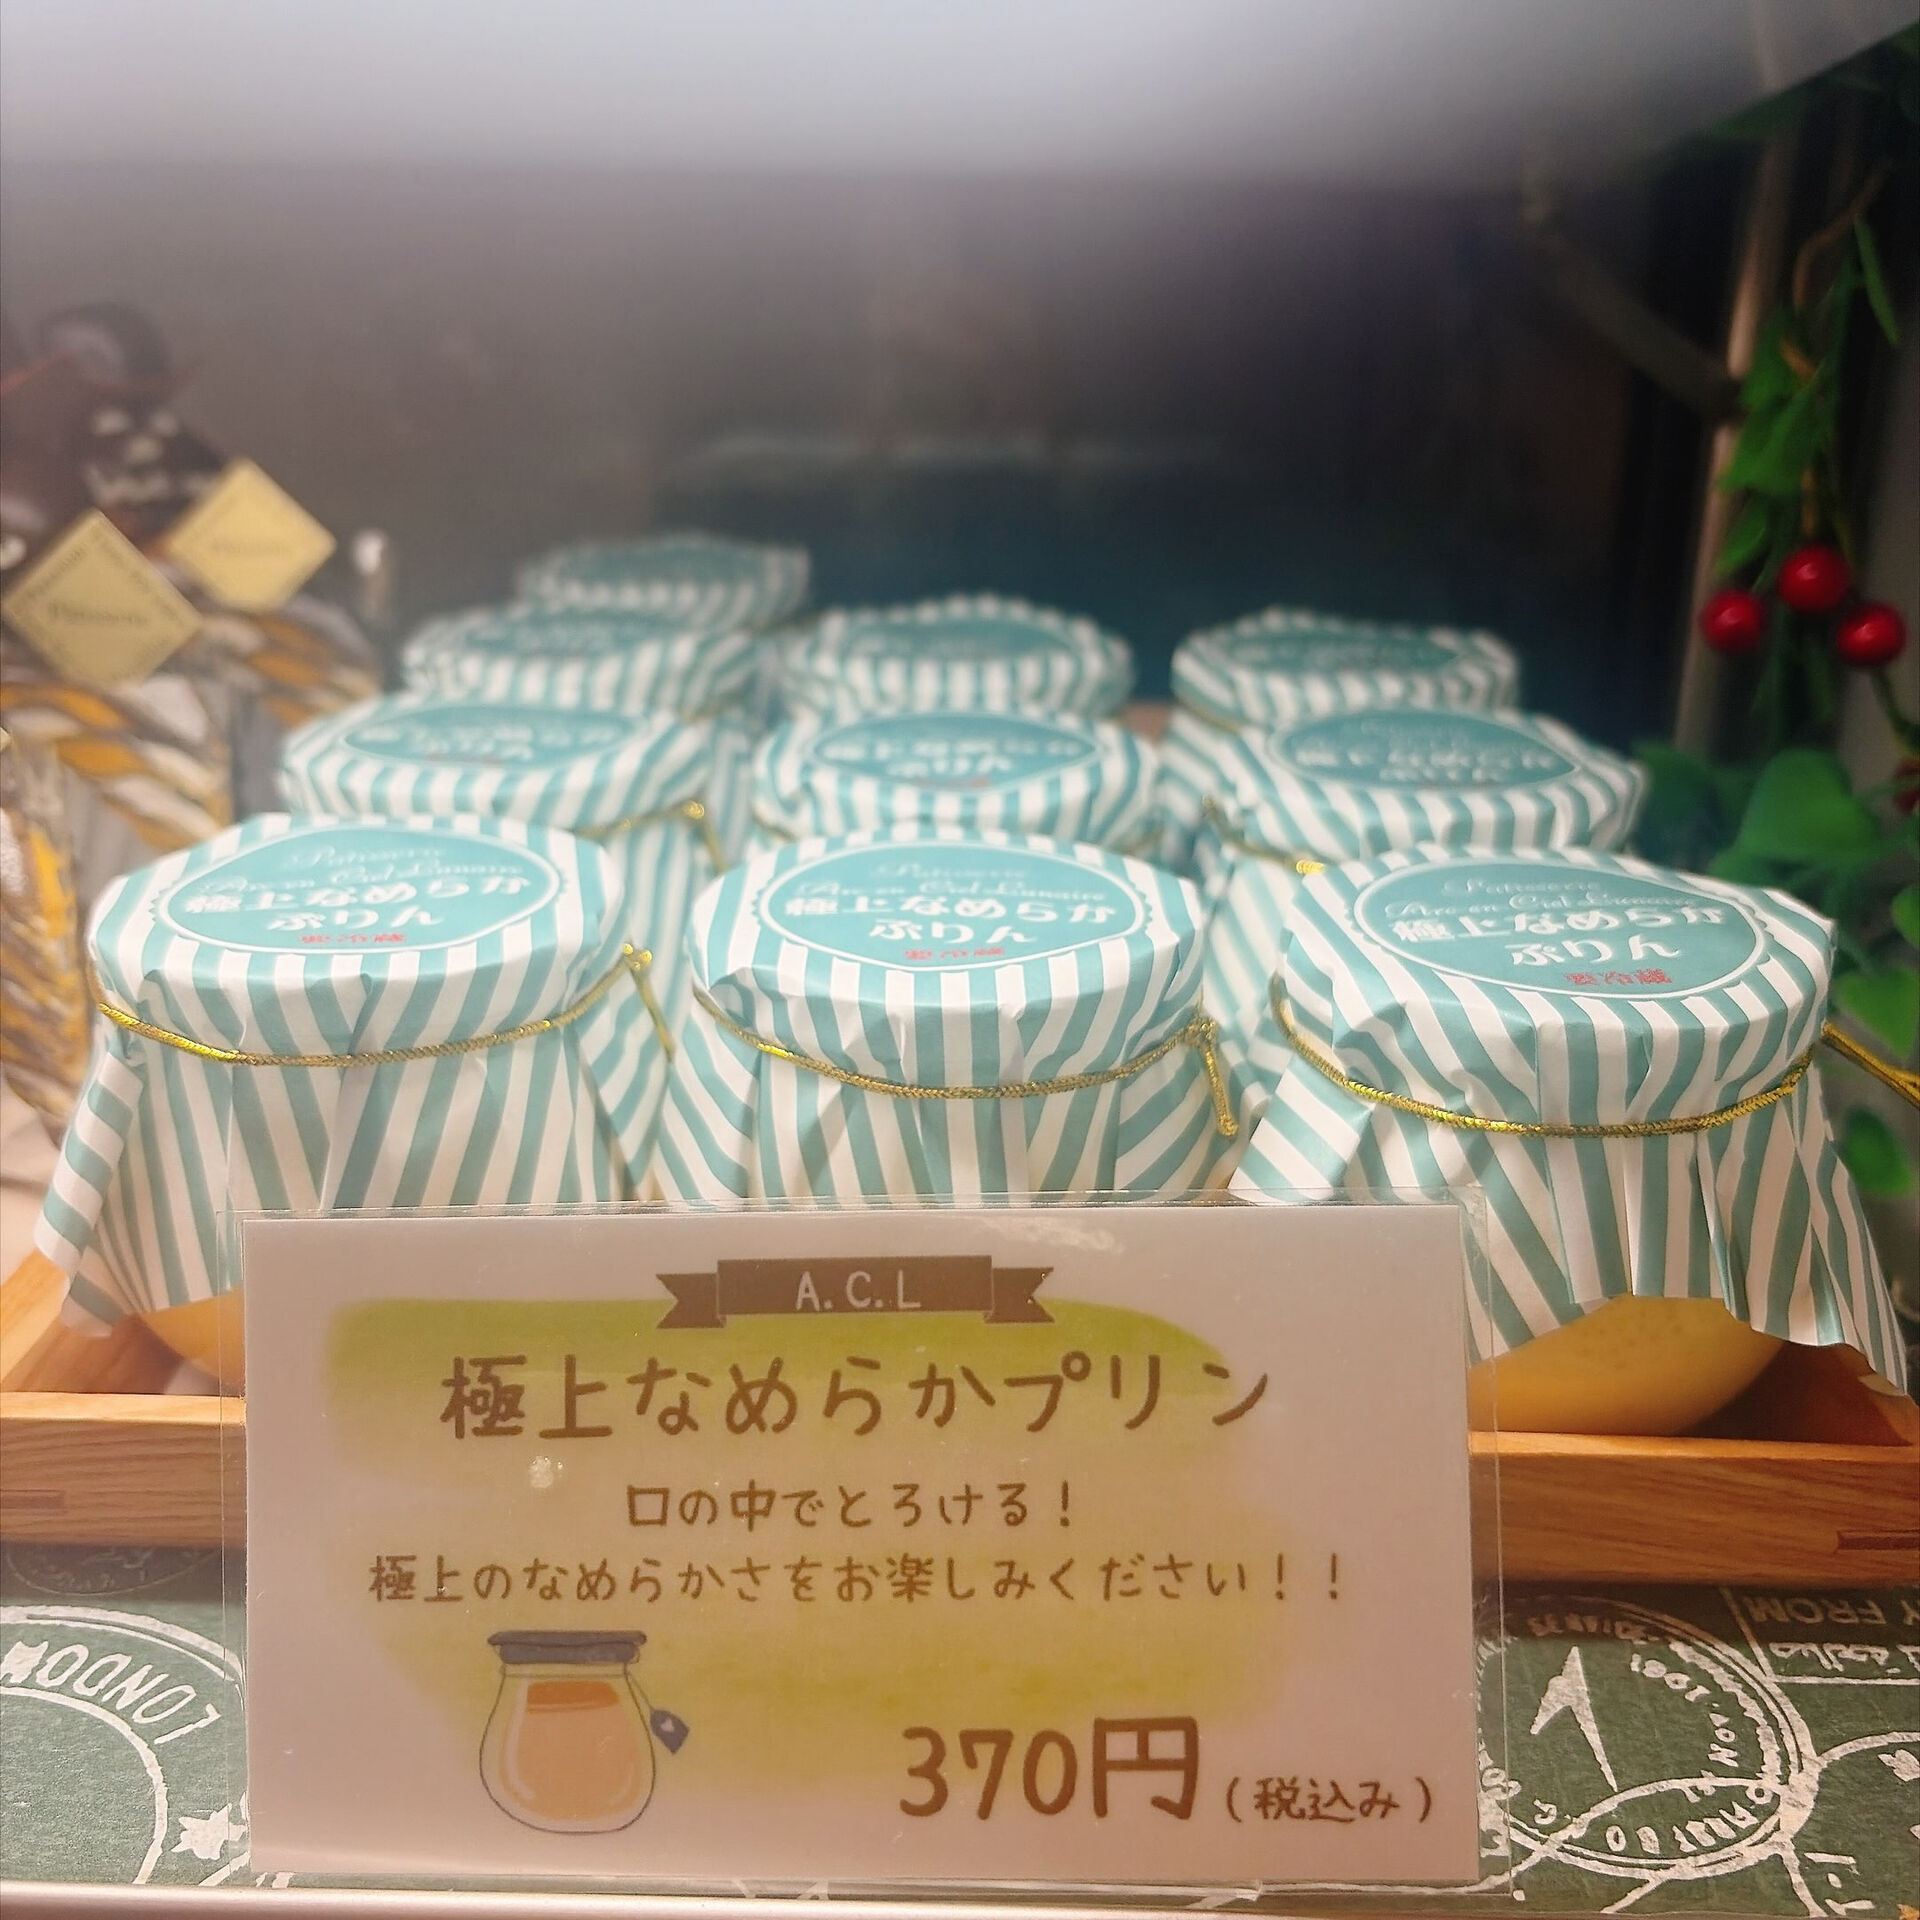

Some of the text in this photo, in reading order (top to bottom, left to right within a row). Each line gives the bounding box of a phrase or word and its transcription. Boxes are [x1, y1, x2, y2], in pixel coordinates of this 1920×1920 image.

[266, 905, 443, 931] ぷりん
[785, 895, 1117, 923] 極上なめらか
[1392, 904, 1724, 943] 極上なめらか
[869, 918, 1037, 944] ぷりん
[1504, 934, 1681, 966] ぷりん
[796, 1270, 922, 1312] A.C.L
[440, 1350, 1268, 1437] 極上なめらかプリン
[626, 1479, 1072, 1533] 口の中でとろける！
[369, 1552, 1340, 1603] 極上のなめらかさをお楽しみください！！
[1743, 1595, 1888, 1627] FROM
[900, 1716, 1199, 1821] 370円
